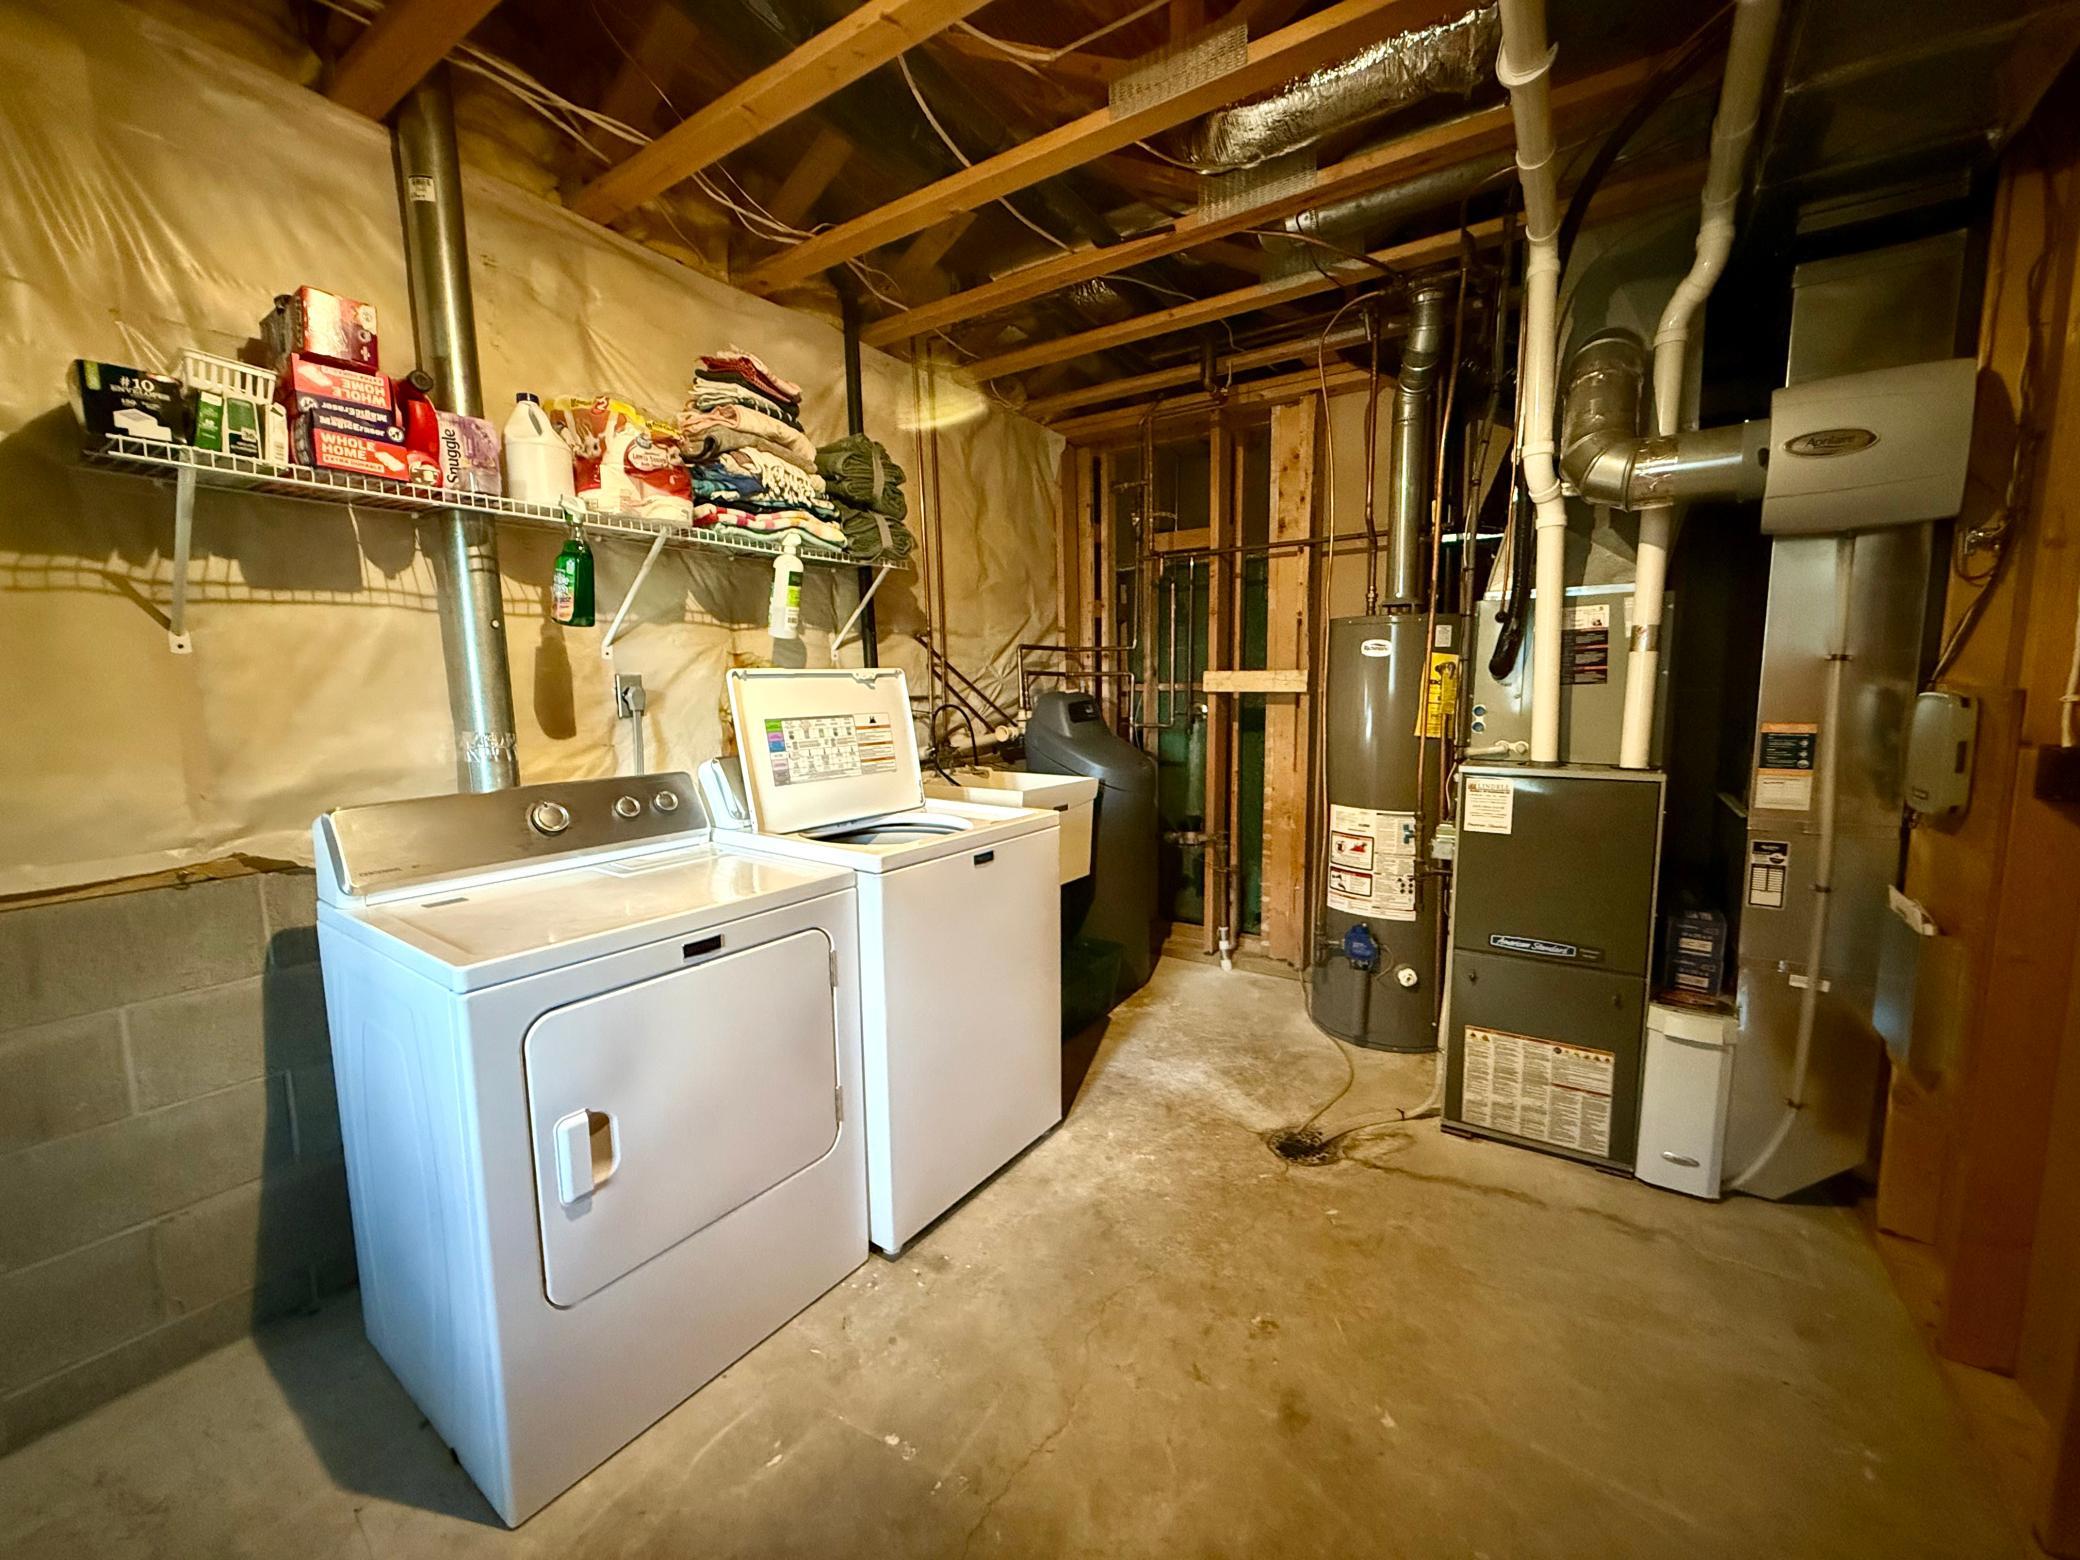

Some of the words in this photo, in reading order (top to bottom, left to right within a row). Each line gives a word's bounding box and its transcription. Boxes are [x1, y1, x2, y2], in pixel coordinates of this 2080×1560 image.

[120, 376, 155, 393] #10
[343, 378, 386, 397] HOME
[331, 386, 387, 409] WHOLE
[320, 432, 376, 452] WHOLE
[321, 443, 367, 461] HOME
[441, 428, 461, 483] Snuggle
[1531, 942, 1568, 955] Standard
